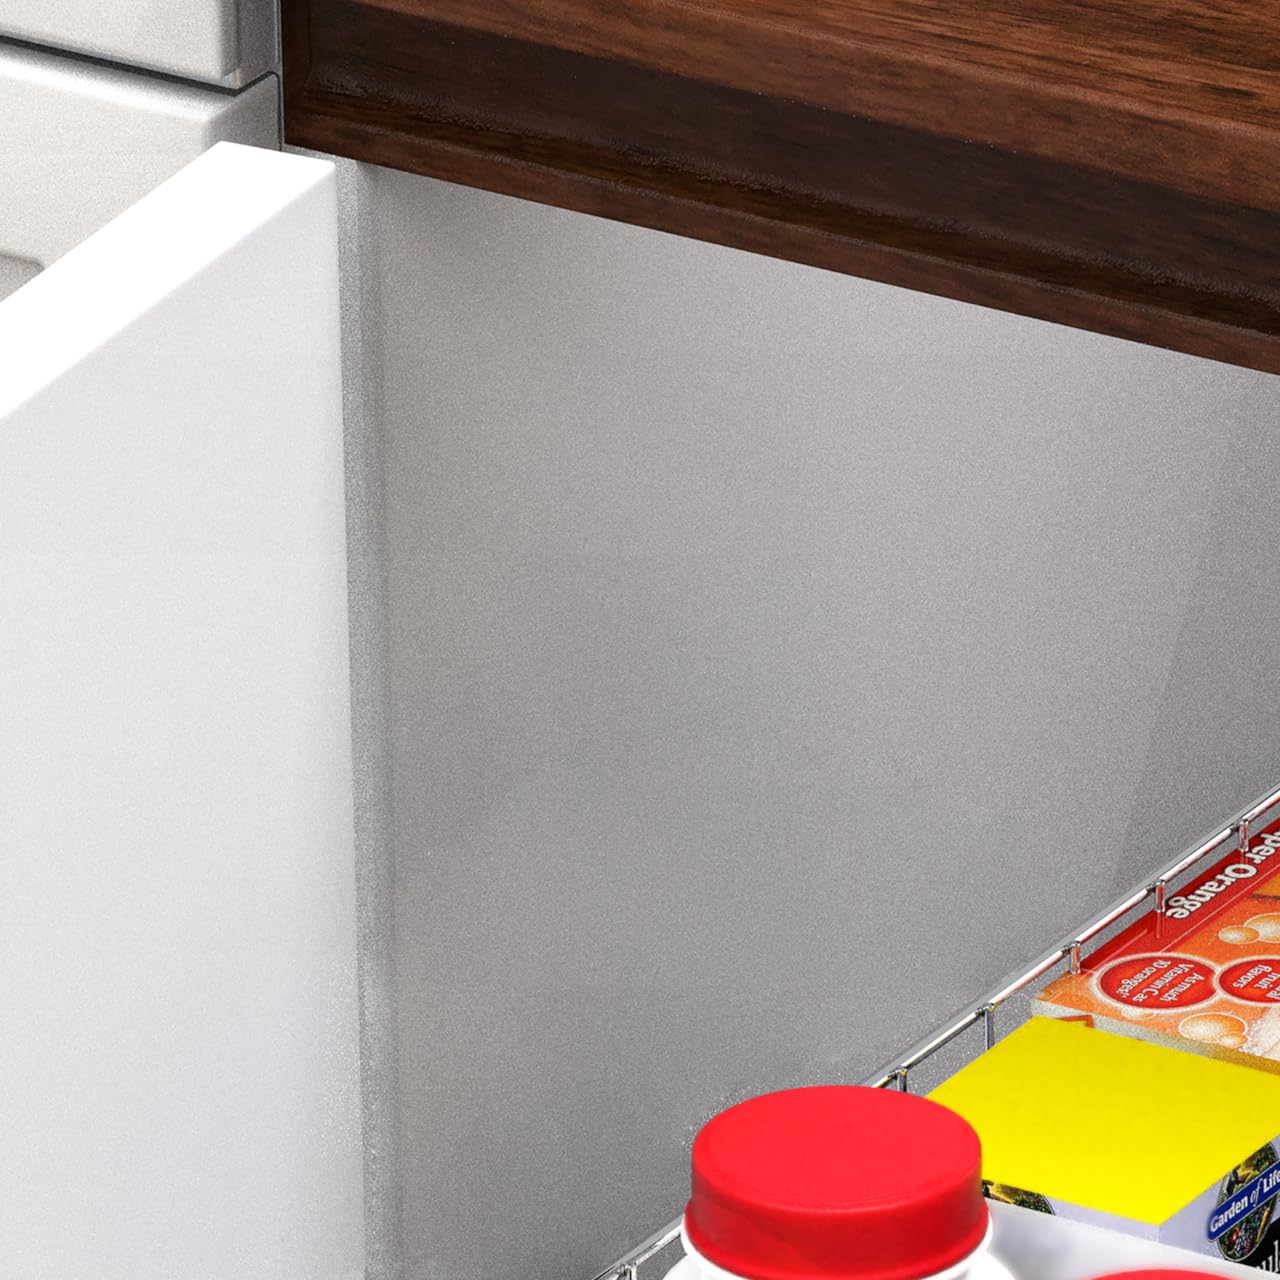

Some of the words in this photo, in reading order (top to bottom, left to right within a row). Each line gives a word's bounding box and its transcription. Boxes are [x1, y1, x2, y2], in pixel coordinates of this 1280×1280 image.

[1165, 863, 1258, 920] Orange
[1210, 1195, 1249, 1232] Garden
[1250, 1178, 1264, 1207] of
